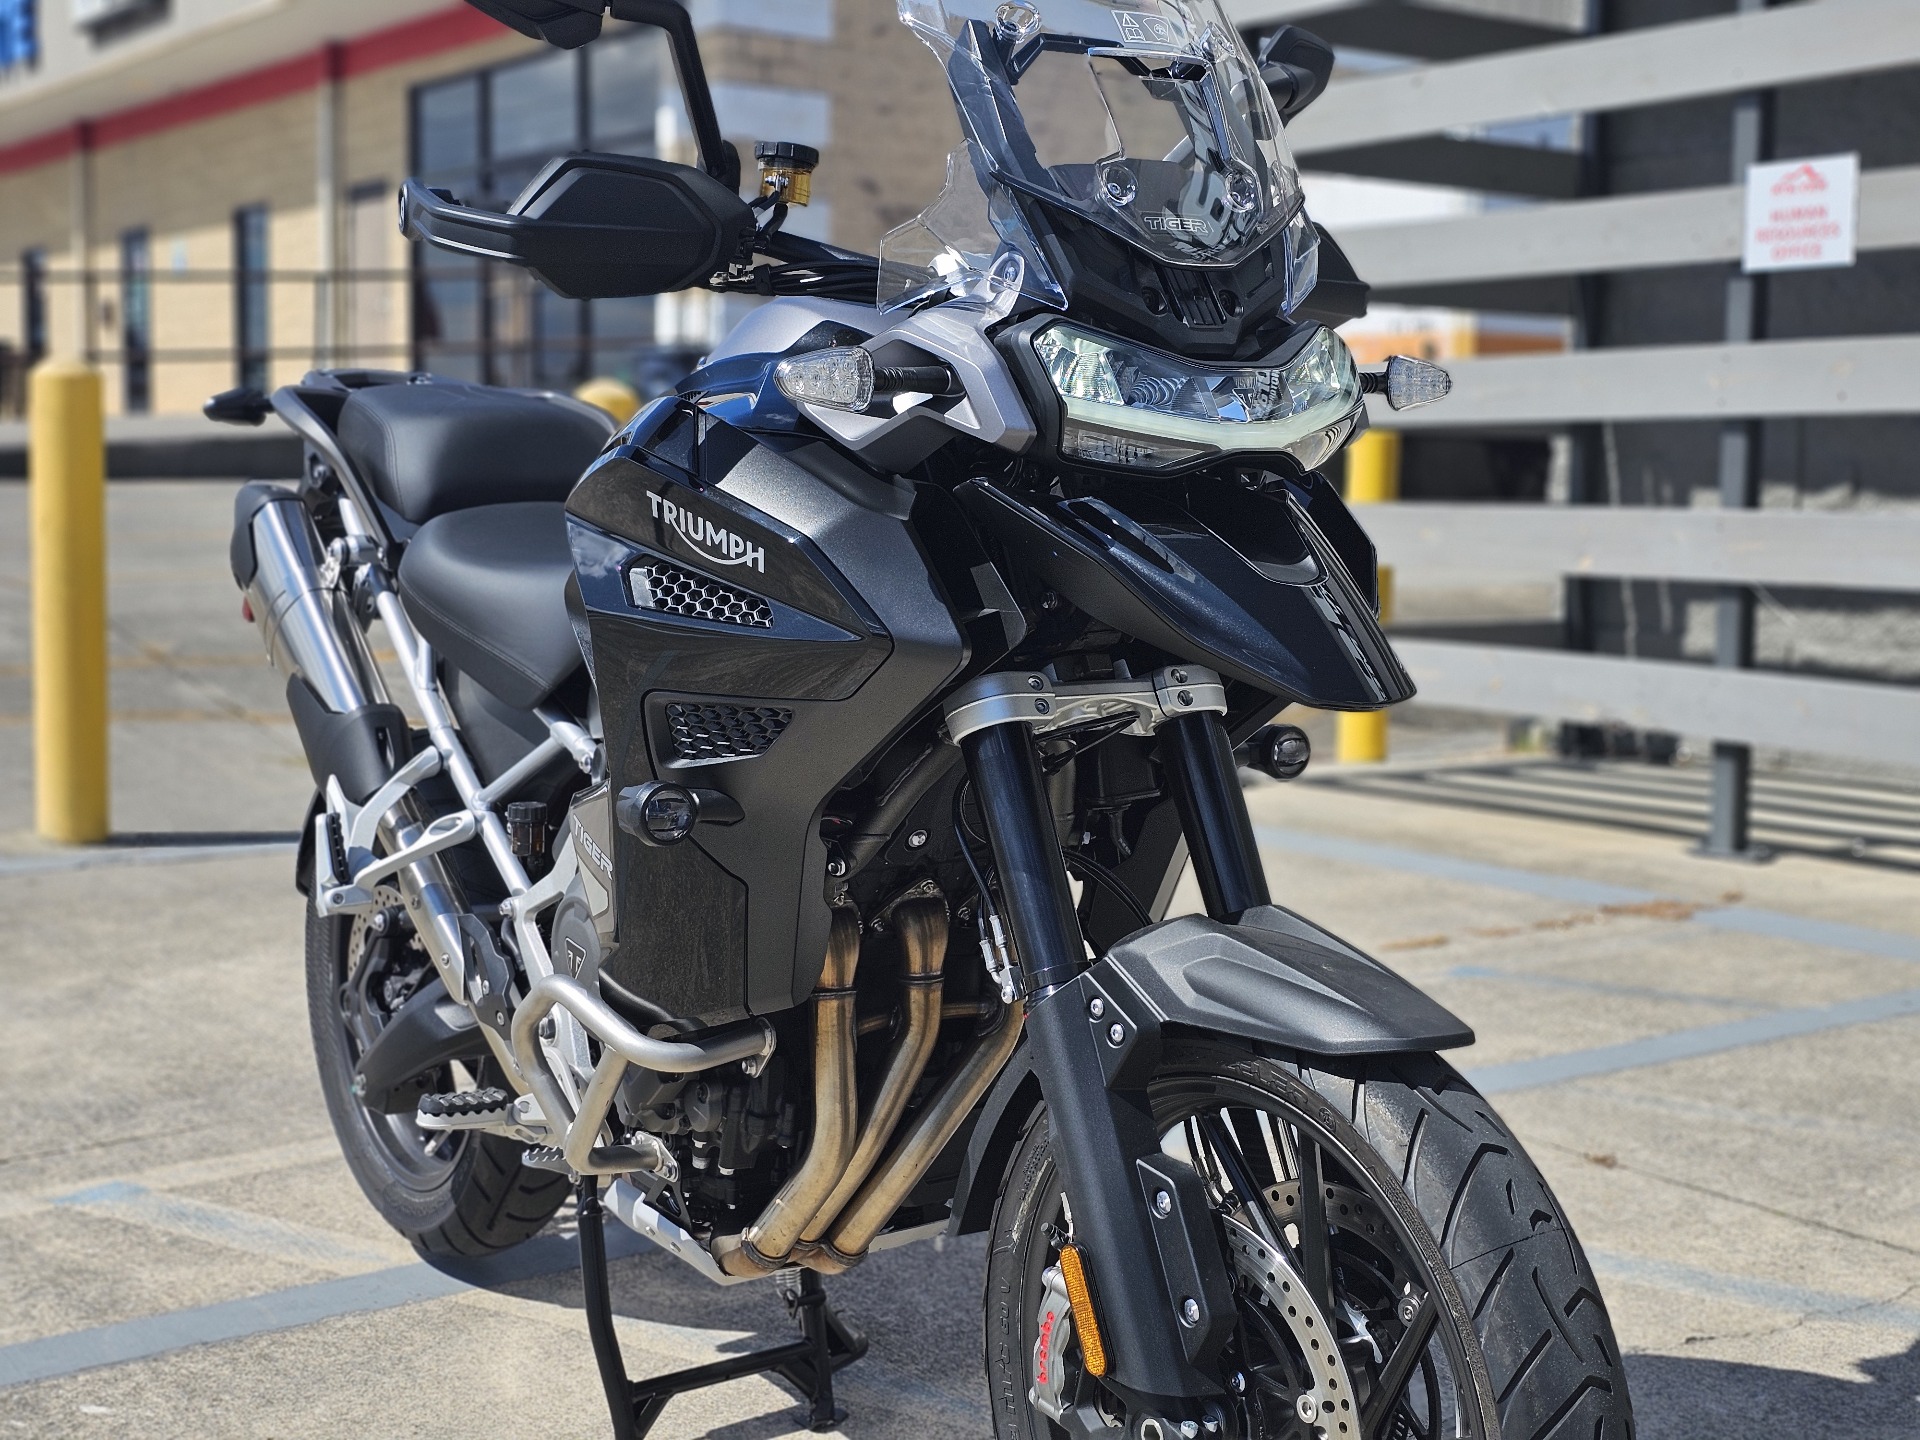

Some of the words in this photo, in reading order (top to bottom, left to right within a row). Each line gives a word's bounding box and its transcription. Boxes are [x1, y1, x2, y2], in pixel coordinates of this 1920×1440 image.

[1144, 217, 1209, 234] TIGER
[646, 490, 765, 574] TRIUMPH
[573, 814, 614, 881] TIGER
[1037, 1311, 1056, 1385] brembo
